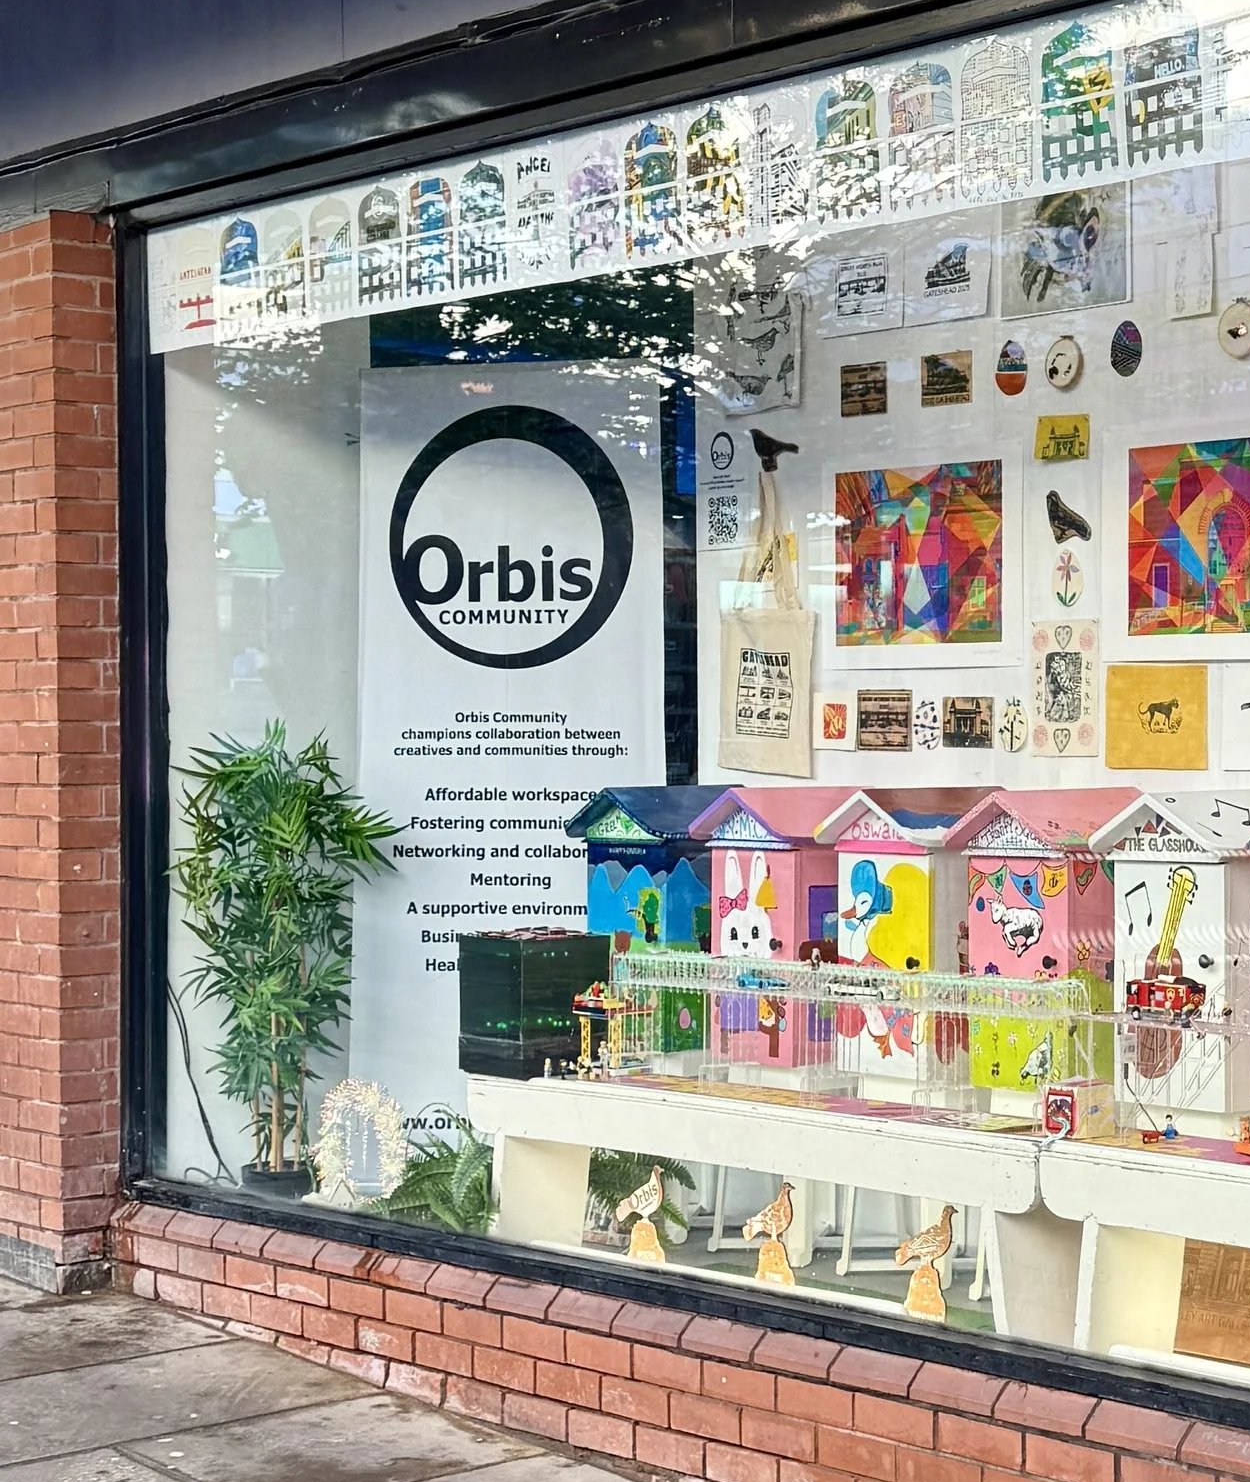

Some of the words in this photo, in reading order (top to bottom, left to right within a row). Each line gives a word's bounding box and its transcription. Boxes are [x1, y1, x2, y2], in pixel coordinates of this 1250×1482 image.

[403, 534, 595, 606] Orbis
[438, 607, 570, 626] COMMUNITY
[454, 711, 489, 724] Orbis
[493, 711, 567, 727] Community
[401, 728, 472, 742] champions
[475, 727, 561, 740] collaboration
[564, 727, 621, 740] between
[393, 744, 453, 757] creatives
[456, 744, 481, 756] and
[484, 744, 568, 756] communities
[571, 744, 628, 759] through:
[425, 787, 508, 802] Affordable
[410, 816, 484, 832] Fostering
[393, 844, 486, 860] Networking
[490, 844, 520, 858] and
[1124, 837, 1145, 852] THE
[1148, 837, 1204, 854] GLASSHOU
[470, 873, 552, 890] Mentoring
[406, 901, 418, 915] A
[421, 901, 508, 918] supportive
[628, 1183, 658, 1211] Orbis
